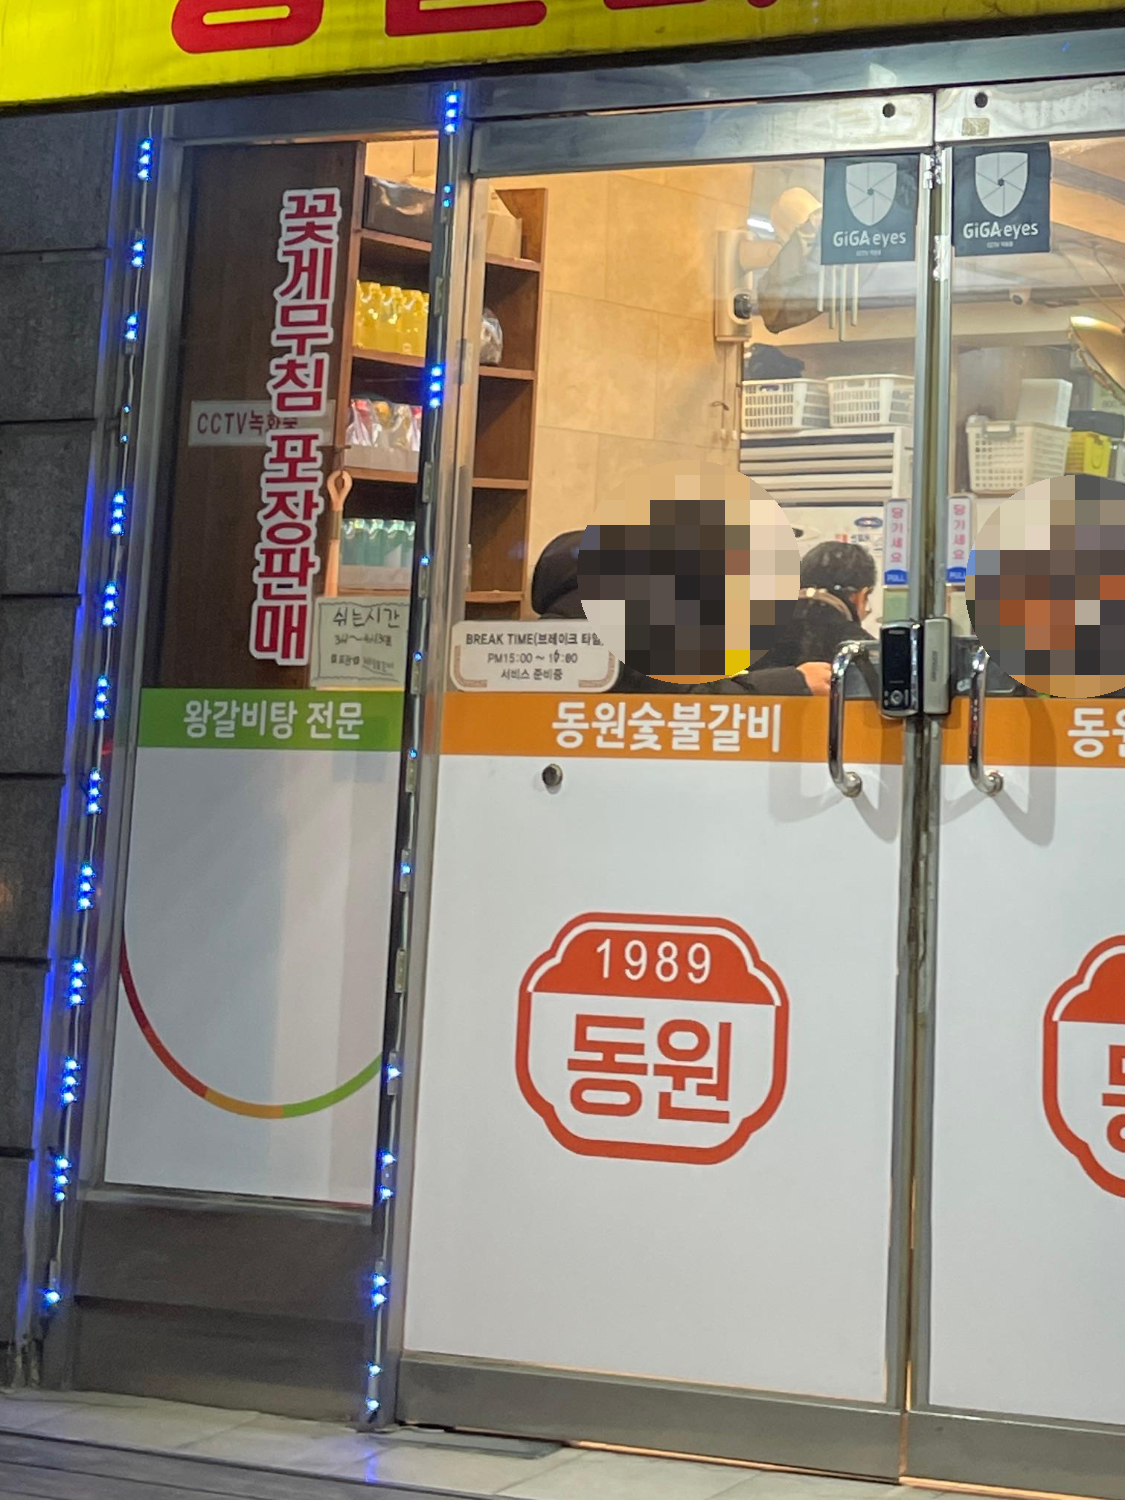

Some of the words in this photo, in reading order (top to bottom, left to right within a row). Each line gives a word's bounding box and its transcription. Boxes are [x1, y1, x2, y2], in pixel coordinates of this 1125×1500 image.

[274, 192, 337, 413] 꽃게무침
[254, 432, 319, 662] 포장판매
[466, 633, 504, 645] BREAK
[507, 632, 578, 646] TIME(브레이크
[487, 652, 533, 664] PM15:00
[500, 668, 531, 680] 서비스
[533, 668, 563, 681] 준비중
[183, 700, 298, 740] 왕갈비탕
[306, 700, 365, 741] 전문
[551, 701, 783, 753] 동원숯불갈비
[595, 937, 712, 985] 1989
[566, 1013, 733, 1125] 동원
